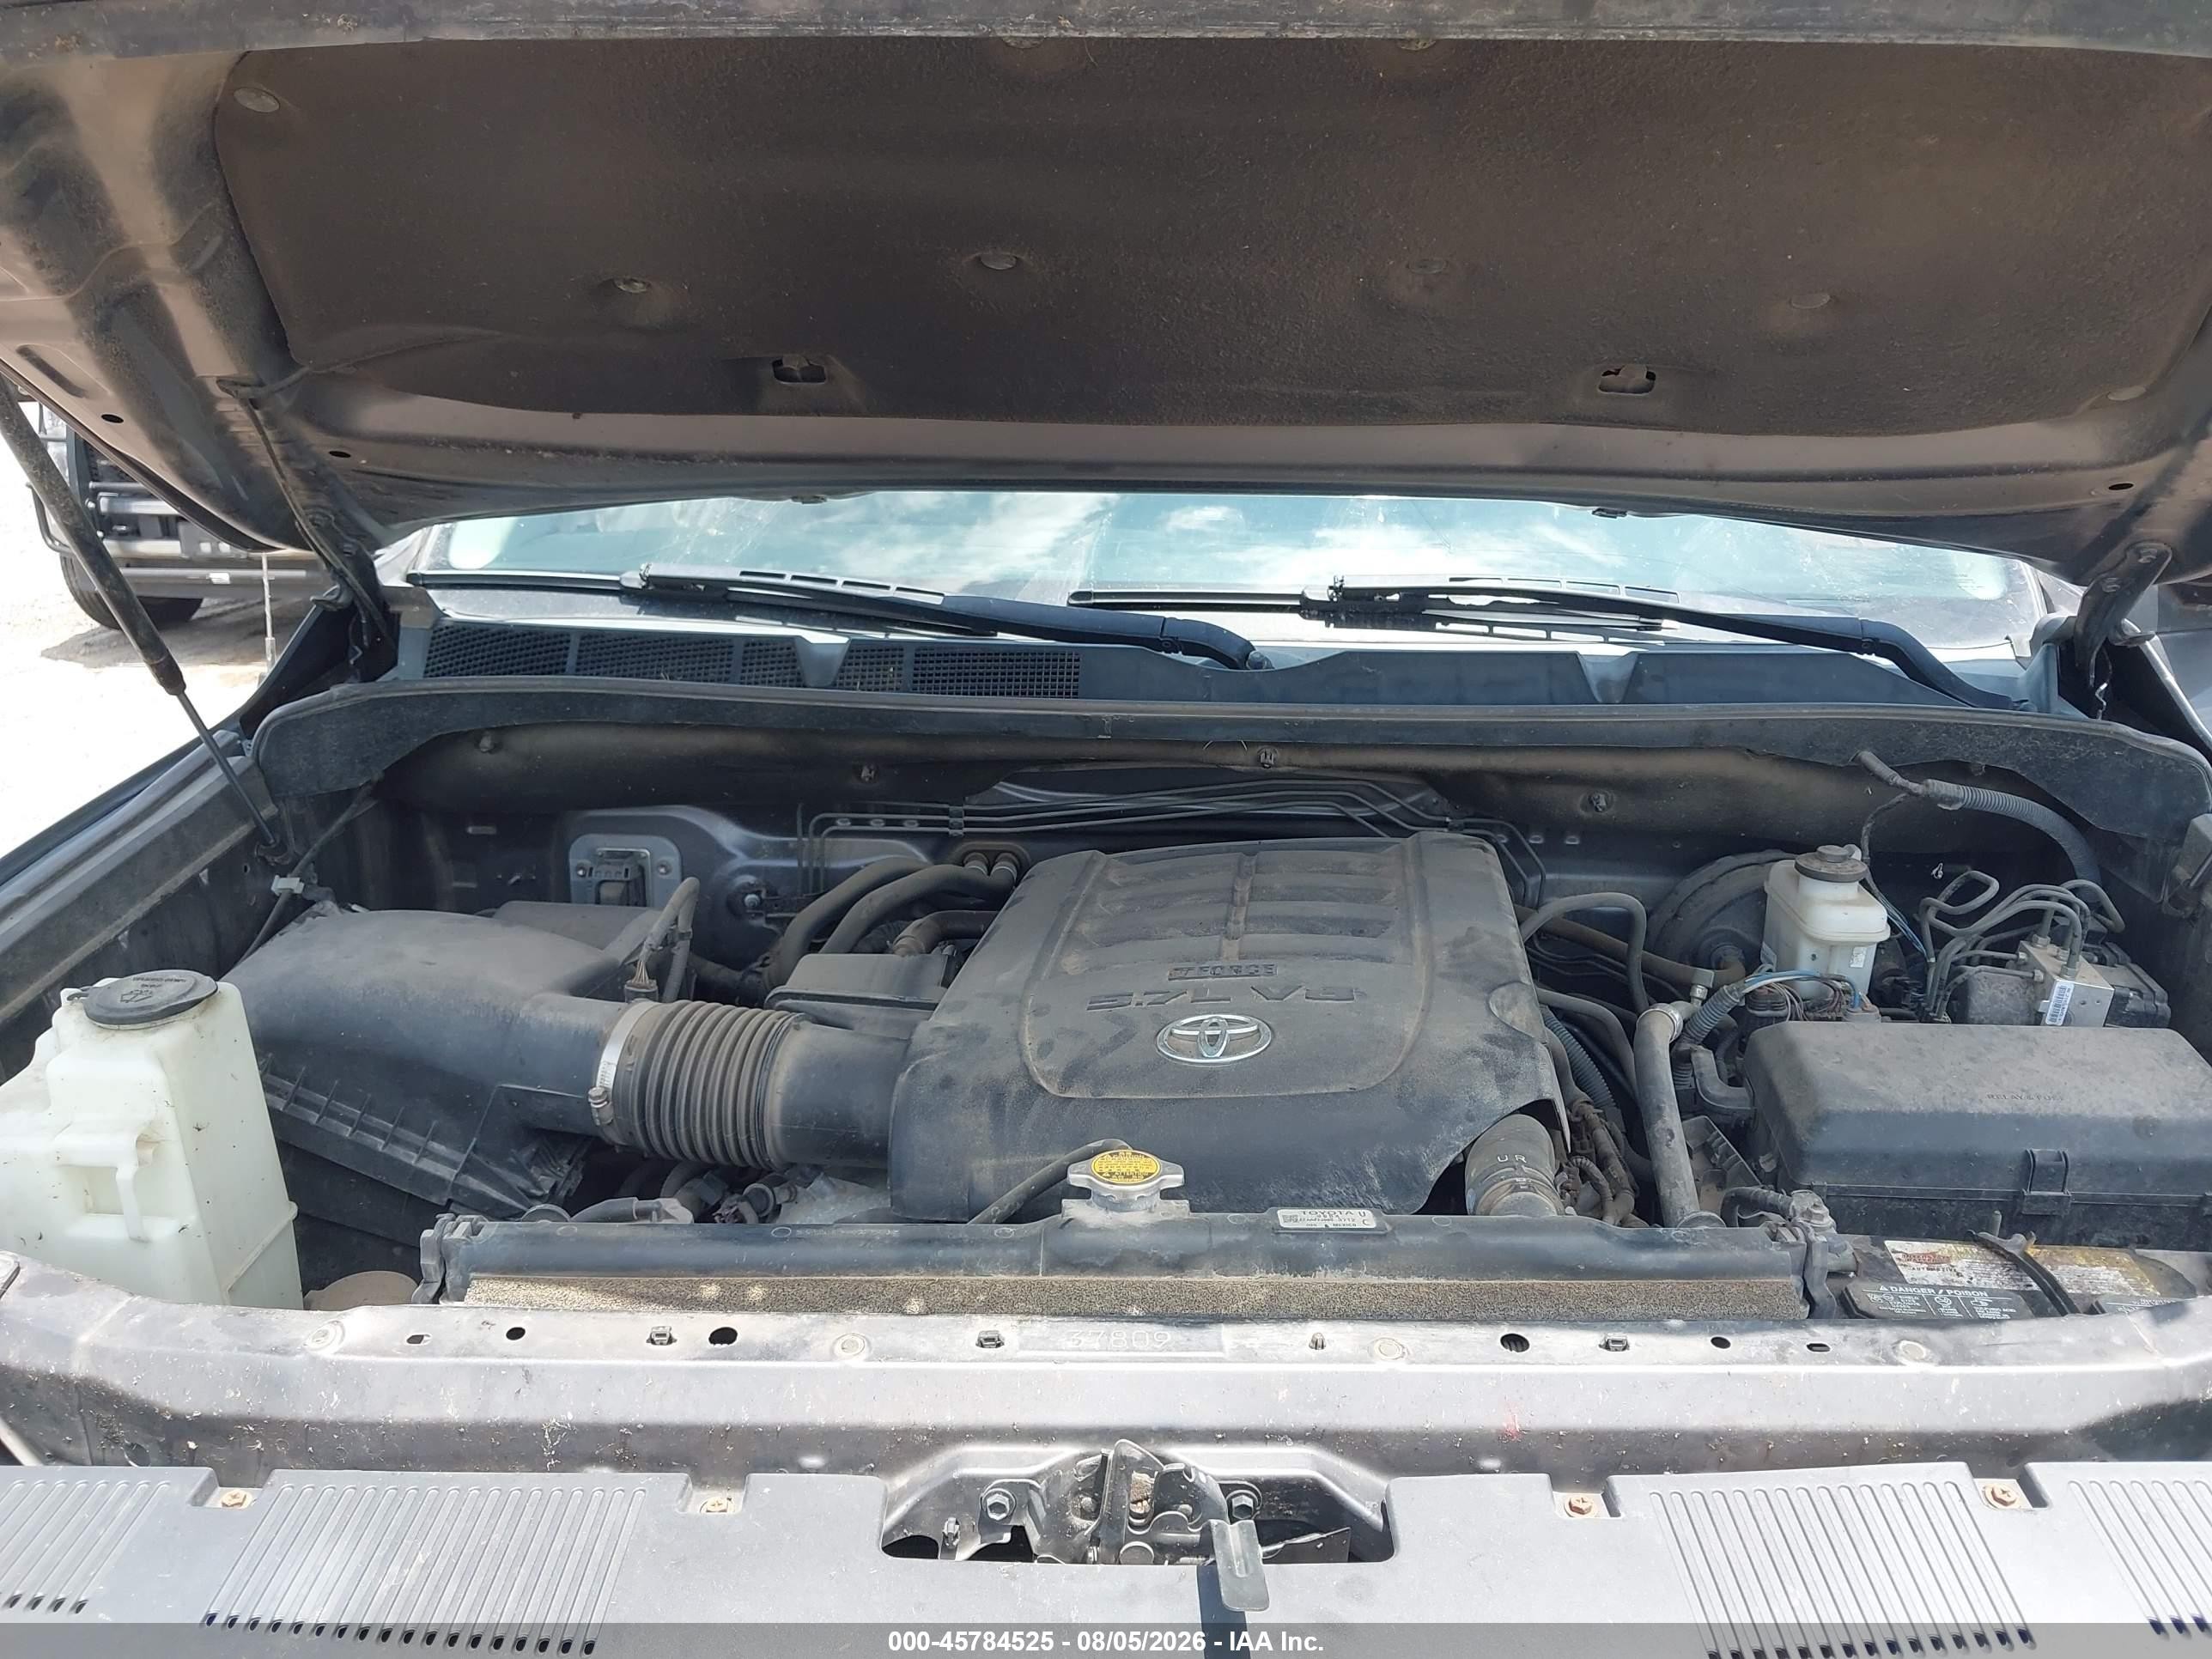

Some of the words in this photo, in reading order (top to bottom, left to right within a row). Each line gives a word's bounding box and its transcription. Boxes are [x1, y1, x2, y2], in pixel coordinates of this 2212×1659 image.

[1086, 986, 1231, 1011] 5.7L
[1249, 985, 1356, 1003] V8
[1889, 1286, 1936, 1295] DANGER
[1946, 1289, 1989, 1297] POISON
[1067, 1329, 1171, 1349] 37809
